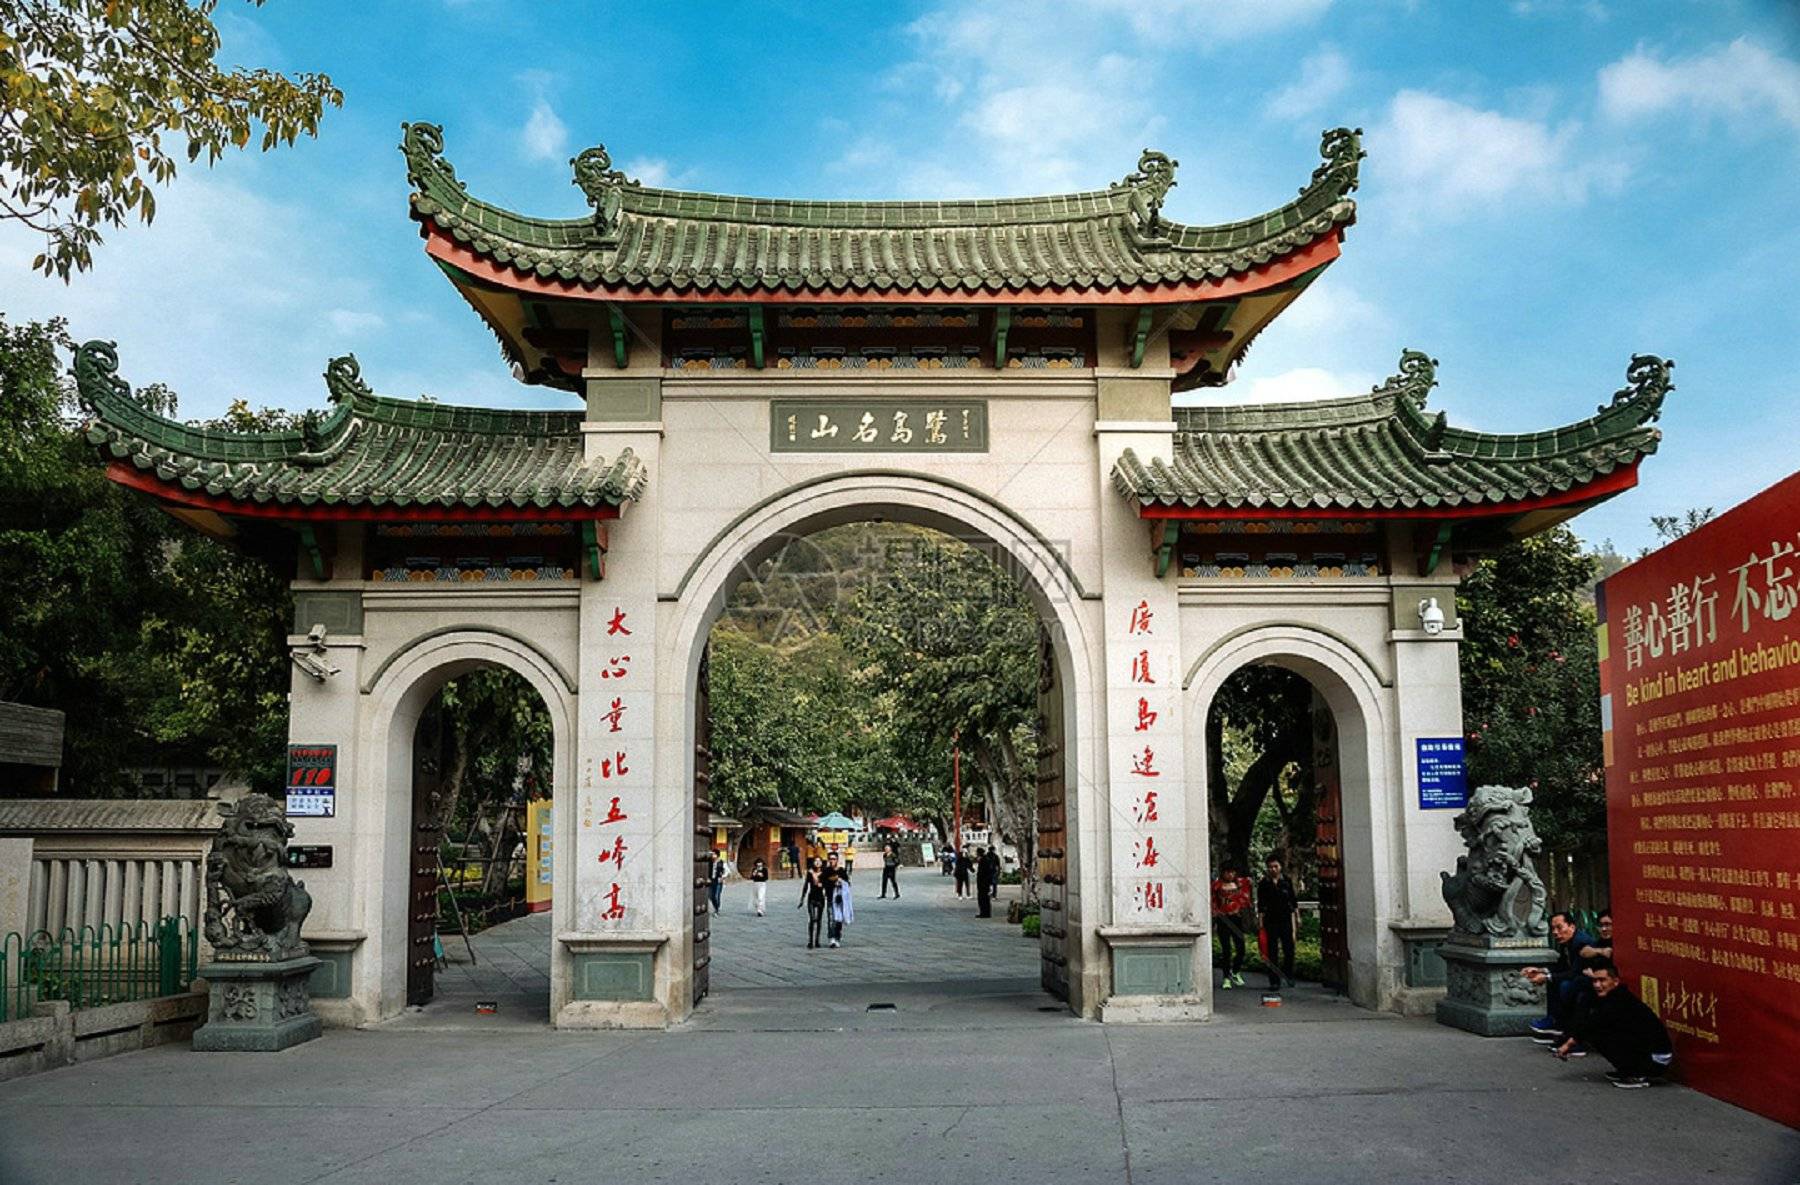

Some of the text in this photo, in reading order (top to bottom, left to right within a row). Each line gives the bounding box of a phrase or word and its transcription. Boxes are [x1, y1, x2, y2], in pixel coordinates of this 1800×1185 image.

[1626, 683, 1639, 707] Be
[1640, 672, 1663, 703] kind
[1664, 670, 1676, 696] in
[1677, 661, 1711, 692] heart
[1712, 650, 1737, 684] and
[291, 768, 332, 785] 110
